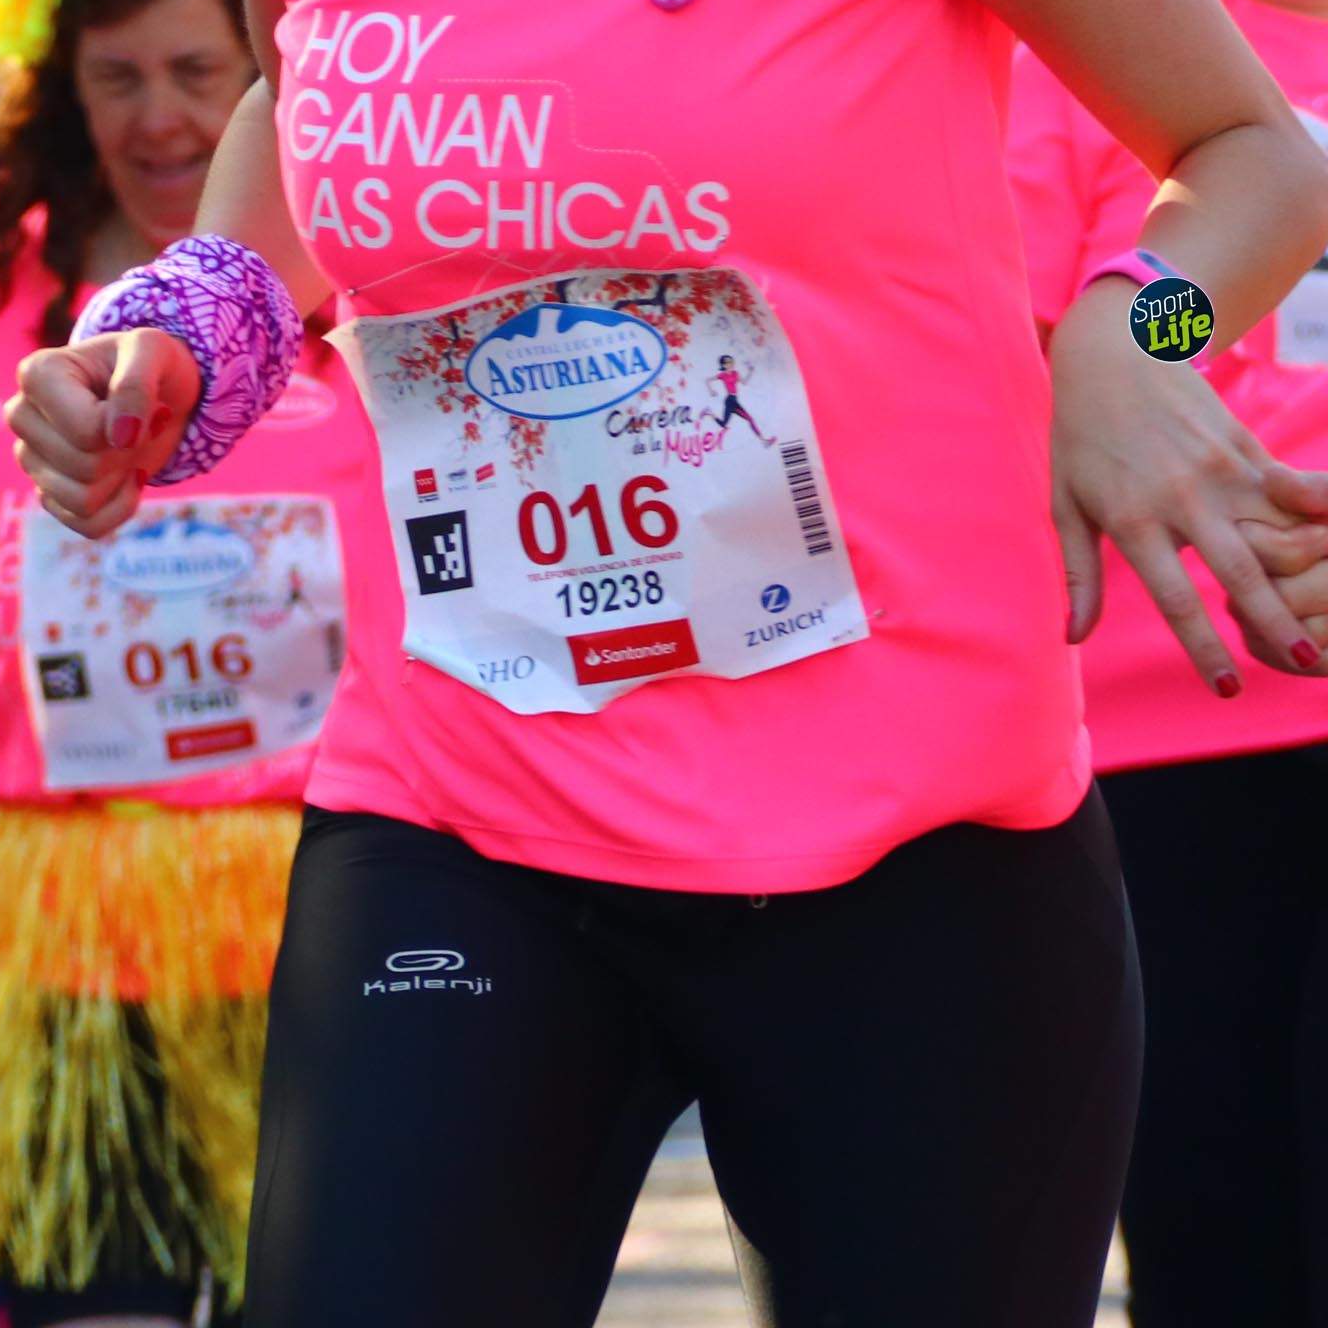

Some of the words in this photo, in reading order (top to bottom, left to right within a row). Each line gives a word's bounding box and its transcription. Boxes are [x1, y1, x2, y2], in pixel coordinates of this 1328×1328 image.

[296, 8, 455, 84] HOY
[287, 89, 552, 169] GANAN
[300, 177, 392, 249] AS
[415, 179, 730, 252] CHICAS
[485, 344, 652, 398] ASTURIANA
[604, 404, 695, 439] Carrera
[663, 427, 728, 469] Mujer
[517, 473, 680, 566] 016
[556, 569, 665, 619] 19238
[601, 639, 678, 666] Santander
[745, 609, 825, 648] ZURICH
[124, 633, 254, 691] 016
